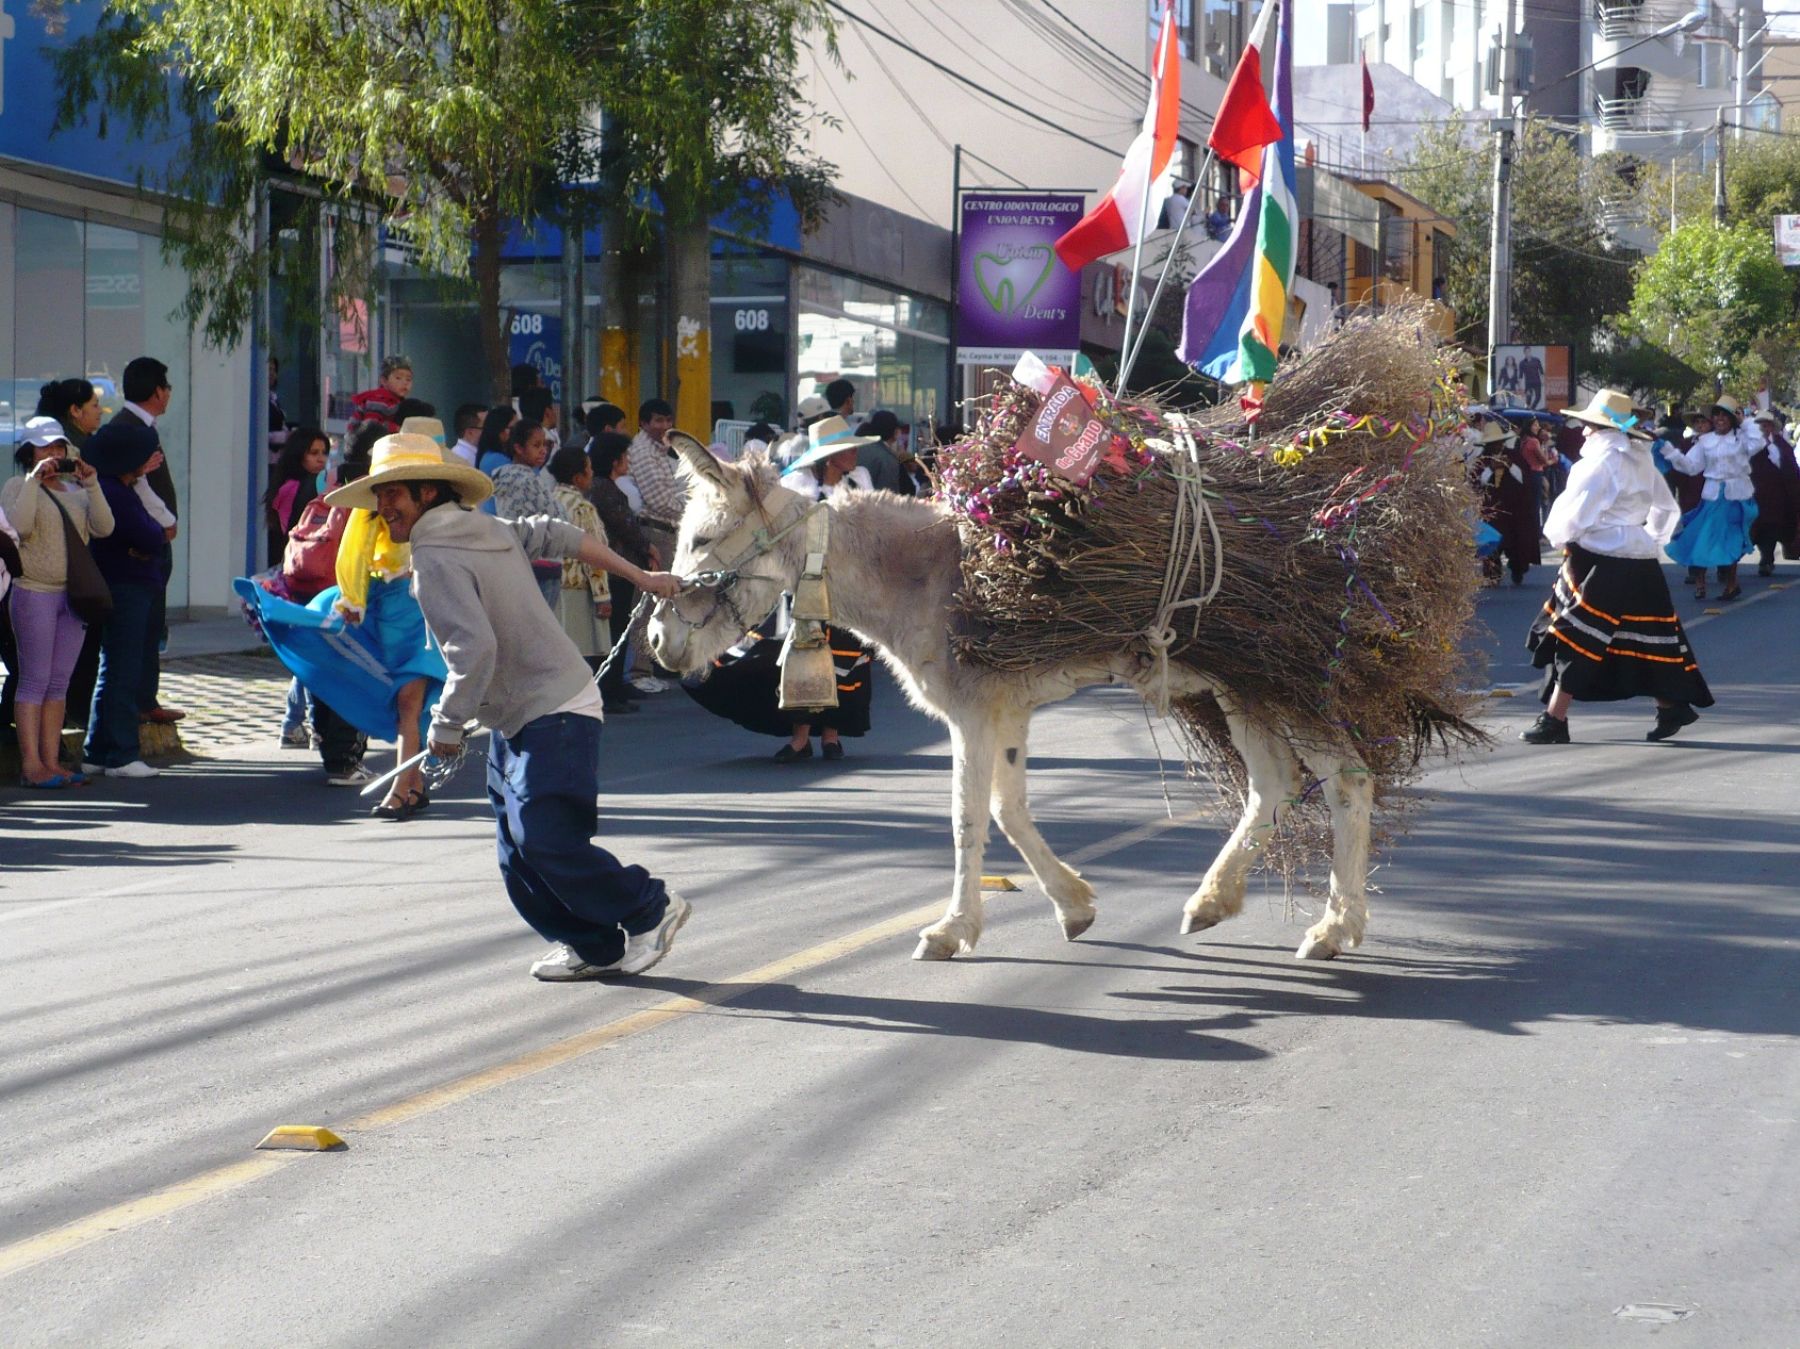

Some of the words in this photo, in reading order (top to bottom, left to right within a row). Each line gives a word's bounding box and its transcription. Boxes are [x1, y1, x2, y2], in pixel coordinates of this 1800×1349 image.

[964, 201, 1003, 211] CENTRO
[1003, 201, 1080, 212] ODONTOLOGICO
[987, 215, 1018, 225] UNION
[1019, 215, 1056, 225] DENT'S
[996, 242, 1042, 260] Union
[733, 309, 769, 330] 608
[1024, 303, 1067, 320] Dent's
[511, 313, 543, 335] 608
[1035, 385, 1080, 444] ENTRADA
[1064, 420, 1103, 464] Ccapo
